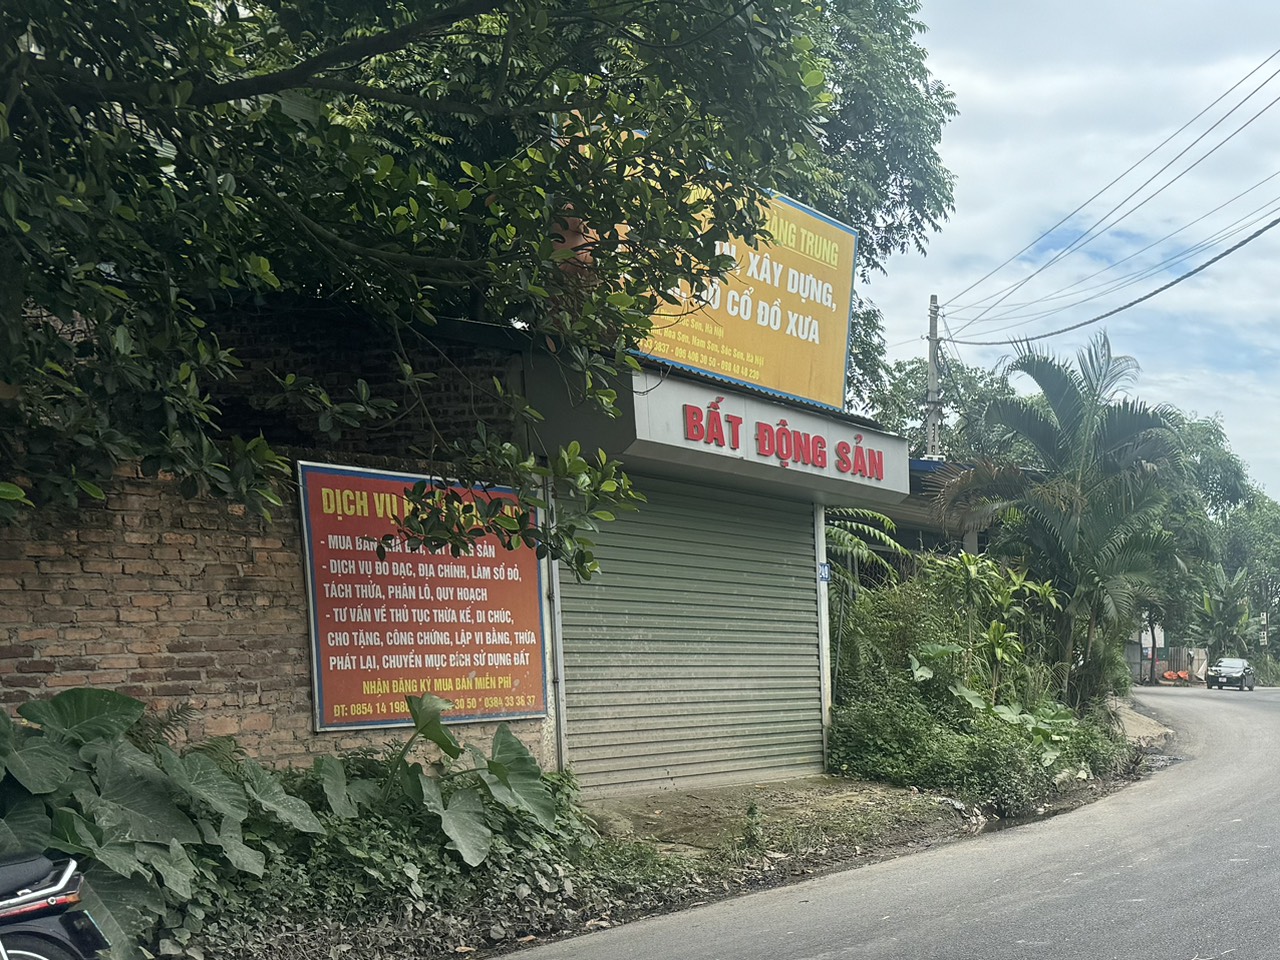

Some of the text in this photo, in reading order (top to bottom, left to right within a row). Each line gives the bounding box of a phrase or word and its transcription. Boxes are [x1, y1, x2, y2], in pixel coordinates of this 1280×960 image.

[800, 227, 839, 266] TRUNG
[746, 251, 784, 288] XÂY
[787, 267, 837, 312] DỰNG,
[727, 286, 754, 320] CỔ
[757, 297, 783, 331] ĐỒ
[785, 310, 820, 344] XƯA
[683, 396, 884, 481] BẤT ĐỘNG SẢN
[321, 487, 369, 520] DỊCH
[373, 492, 398, 524] VỤ
[327, 534, 353, 550] MUA
[355, 533, 378, 551] BÁN
[476, 540, 495, 558] SẢN
[329, 559, 522, 582] DỊCH VỤ ĐO ĐẠC, ĐỊA CHÍNH, LÀM SỔ ĐỎ,
[323, 580, 488, 603] TÁCH THỬA, PHÂN LÔ, QUY HOẠCH
[332, 606, 348, 622] TƯ
[349, 603, 372, 622] VẤN
[389, 604, 409, 623] THỦ
[411, 609, 430, 626] TỤC
[432, 606, 457, 623] THỪA
[459, 605, 474, 624] KẾ,
[476, 609, 485, 623] DI
[487, 607, 514, 625] CHÚC,
[327, 626, 537, 649] CHO TẶNG, CÔNG CHỨNG, LẬP VI BẰNG, THỪA
[329, 648, 530, 672] PHÁT LẠI, CHUYỂN MỤC ĐÍCH SỬ DỤNG ĐẤT
[362, 672, 512, 697] NHẬN ĐĂNG KÝ MUA BÁN MIỄN PHÍ
[333, 704, 348, 717] ĐT:
[350, 703, 373, 716] 0854
[375, 702, 387, 714] 14
[454, 698, 465, 709] 30
[466, 697, 477, 709] 50
[504, 695, 514, 707] 33
[526, 694, 536, 706] 37
